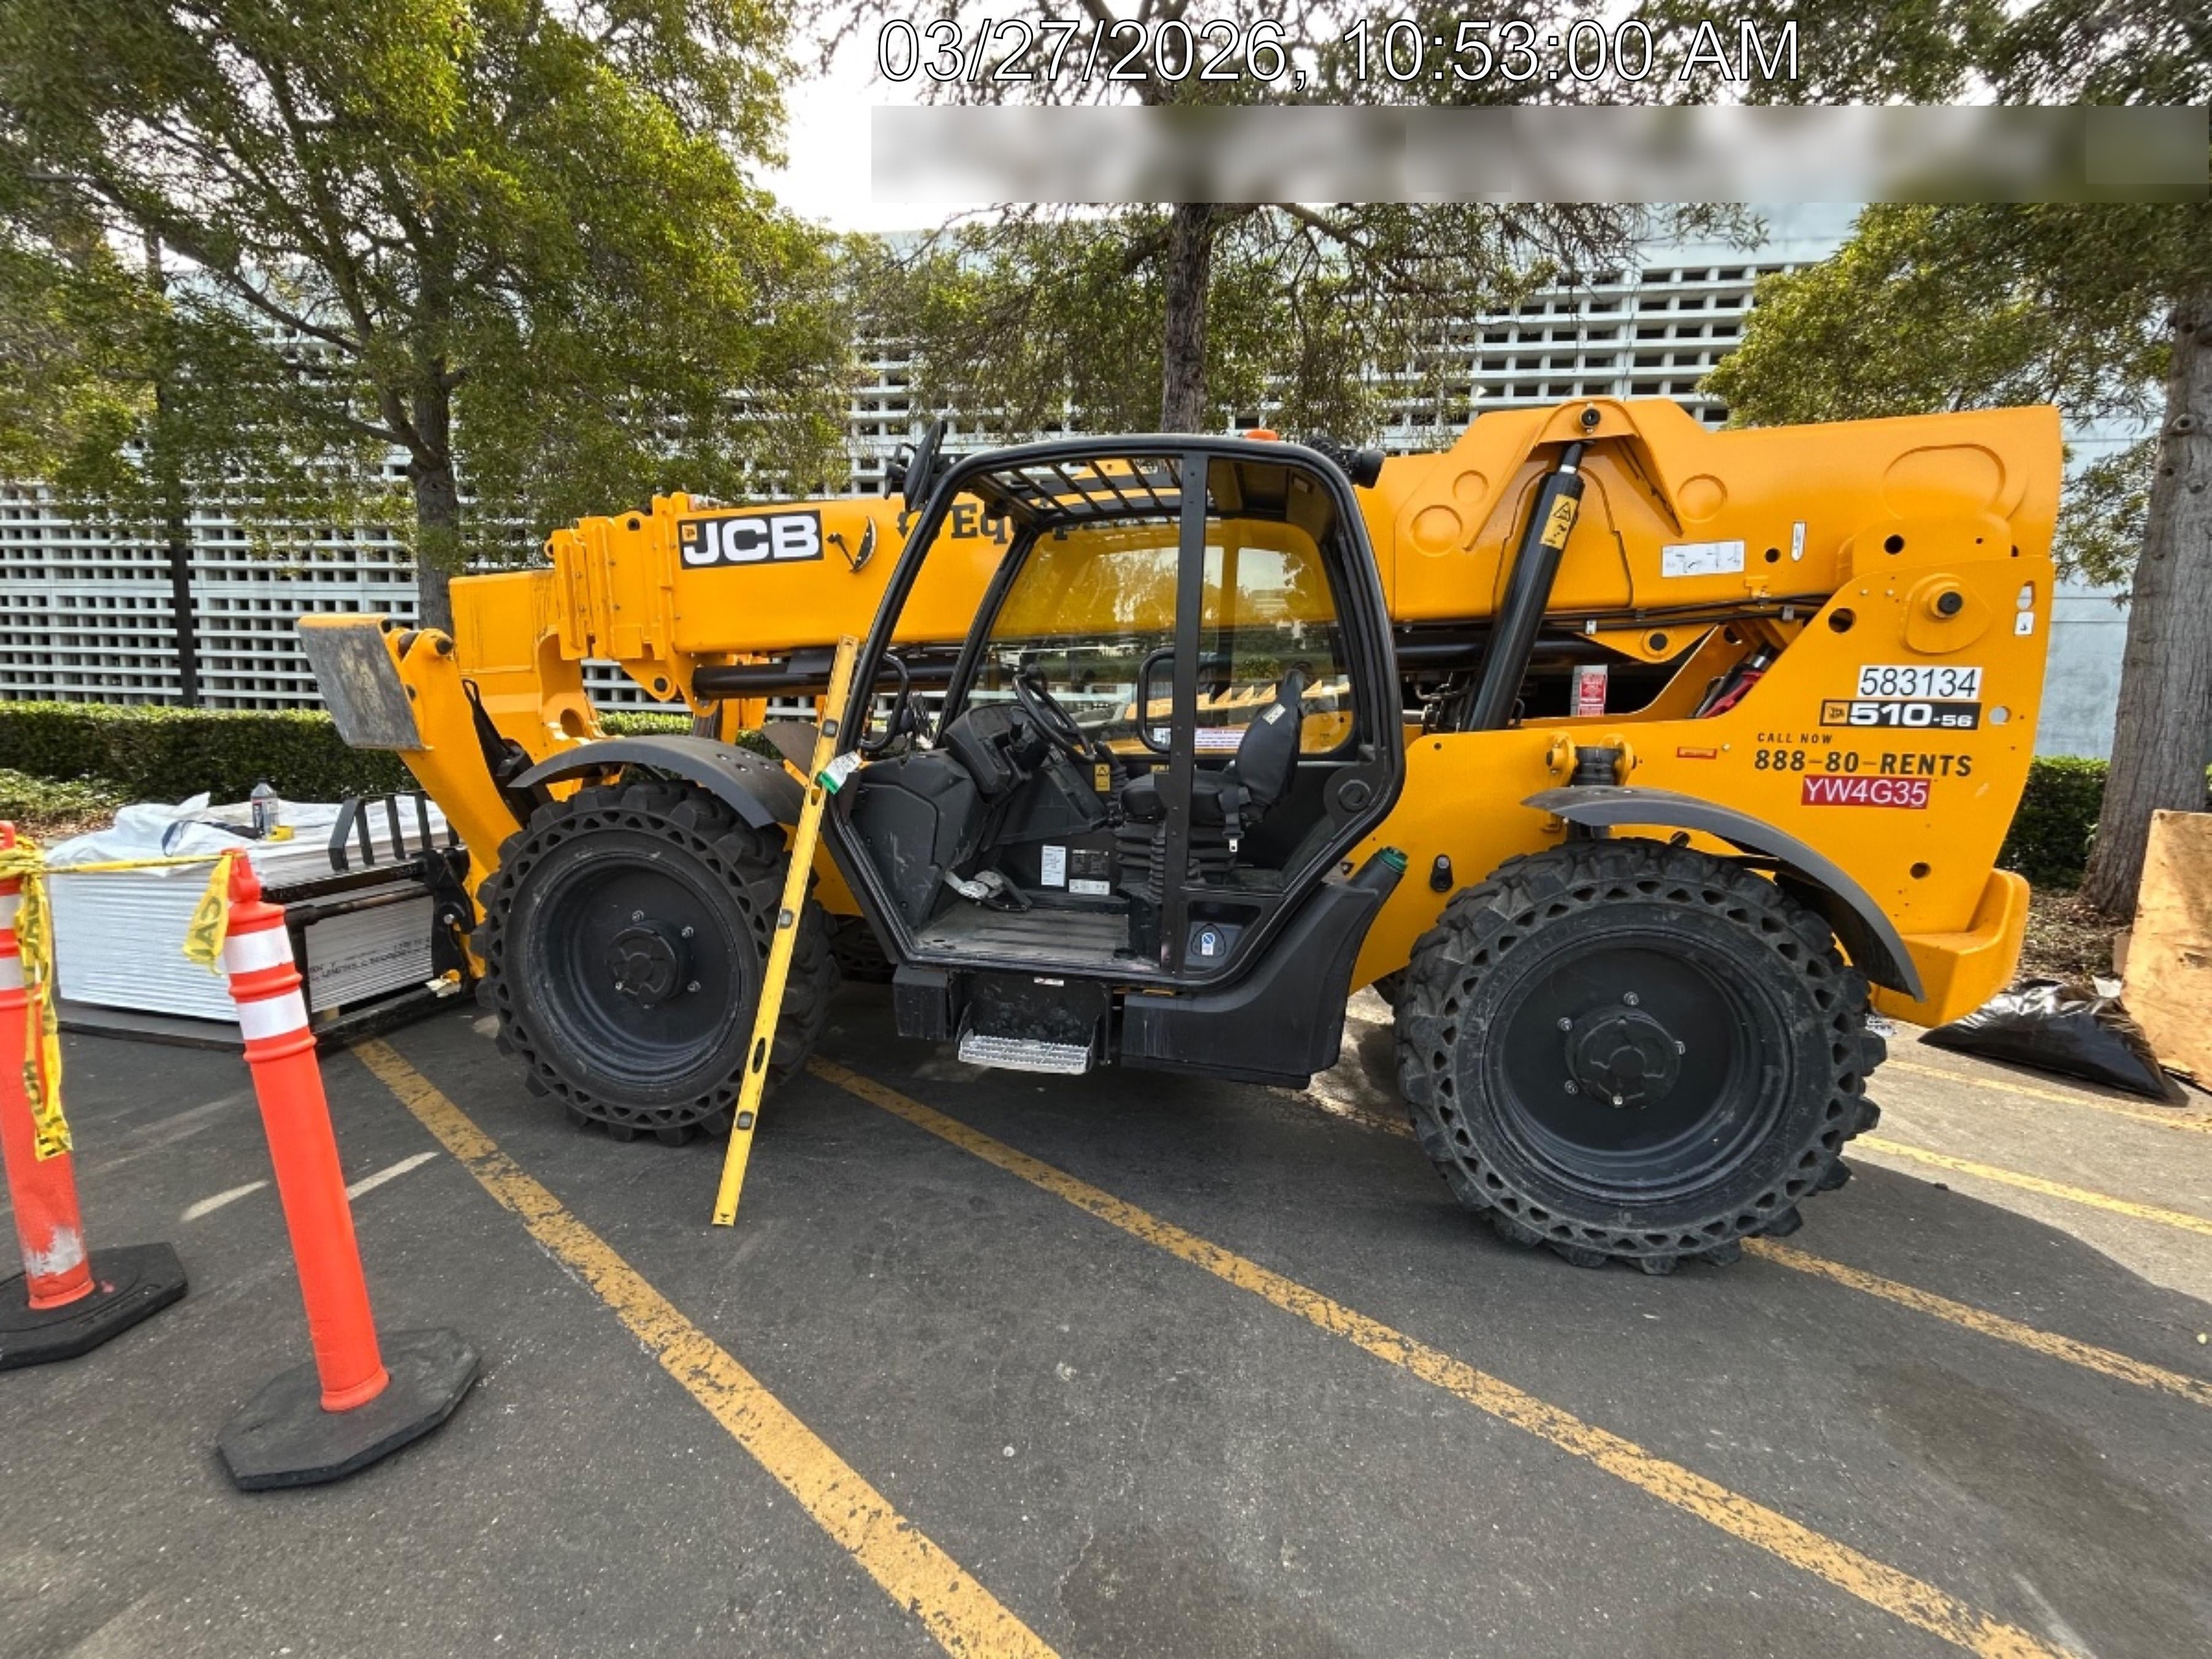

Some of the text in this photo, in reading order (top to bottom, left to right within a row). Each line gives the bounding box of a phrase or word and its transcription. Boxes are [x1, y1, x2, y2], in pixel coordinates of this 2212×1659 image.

[683, 515, 819, 565] JCB
[1861, 668, 1975, 697] 583134
[1757, 732, 1833, 743] CALL NOW
[1754, 749, 1973, 776] 888-80-RENTS
[1805, 777, 1928, 805] YW4G35
